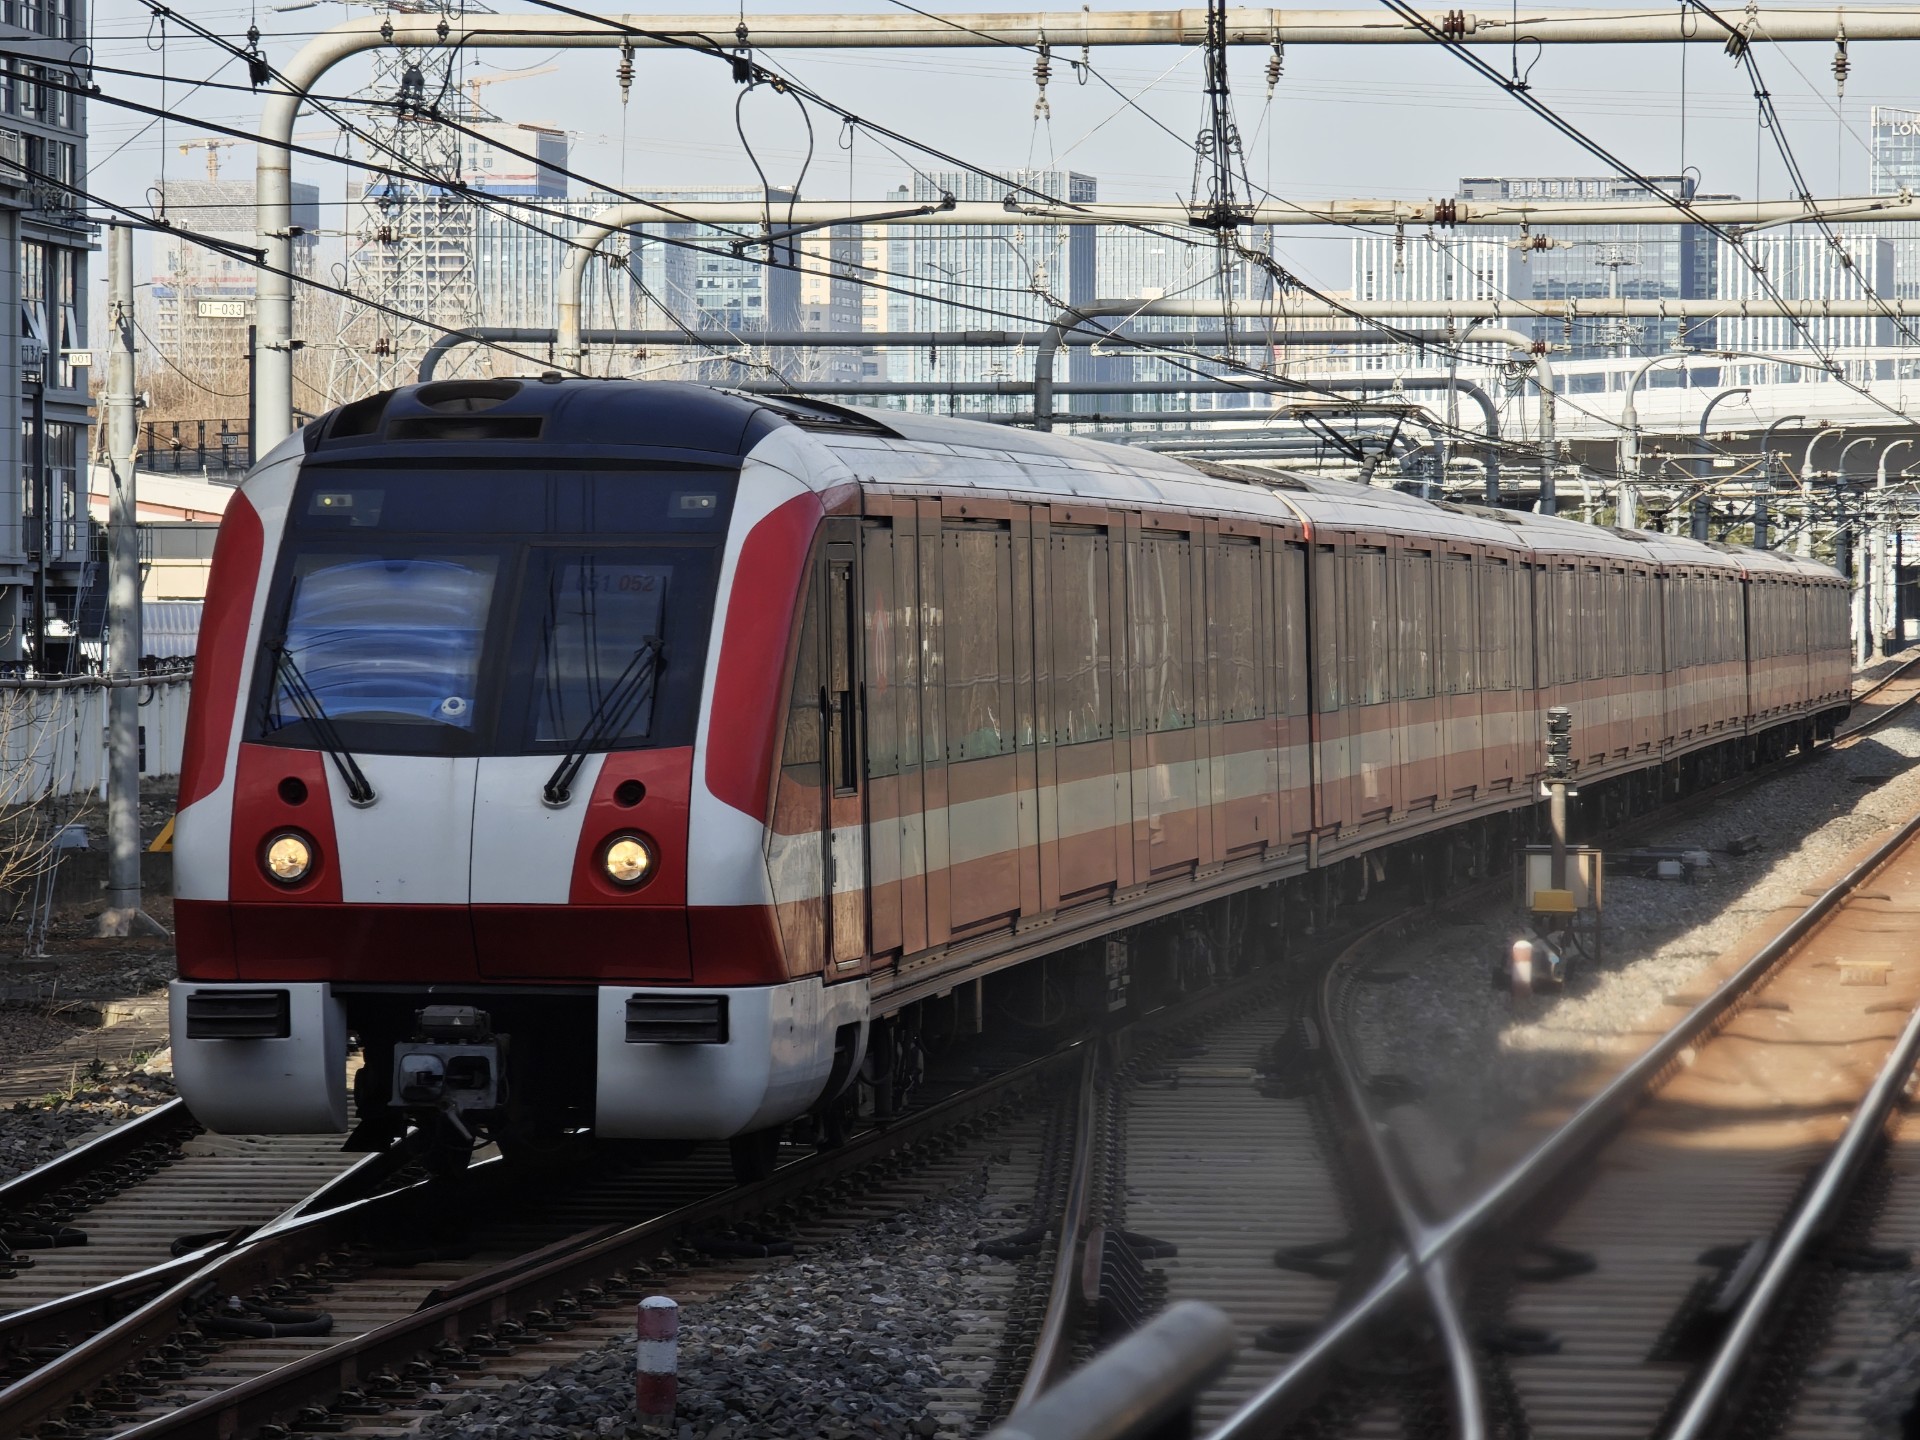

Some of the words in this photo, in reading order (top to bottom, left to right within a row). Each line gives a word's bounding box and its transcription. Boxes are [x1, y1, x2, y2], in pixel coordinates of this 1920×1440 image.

[200, 303, 242, 315] 01-033
[72, 355, 88, 363] 001
[618, 574, 655, 592] 052
